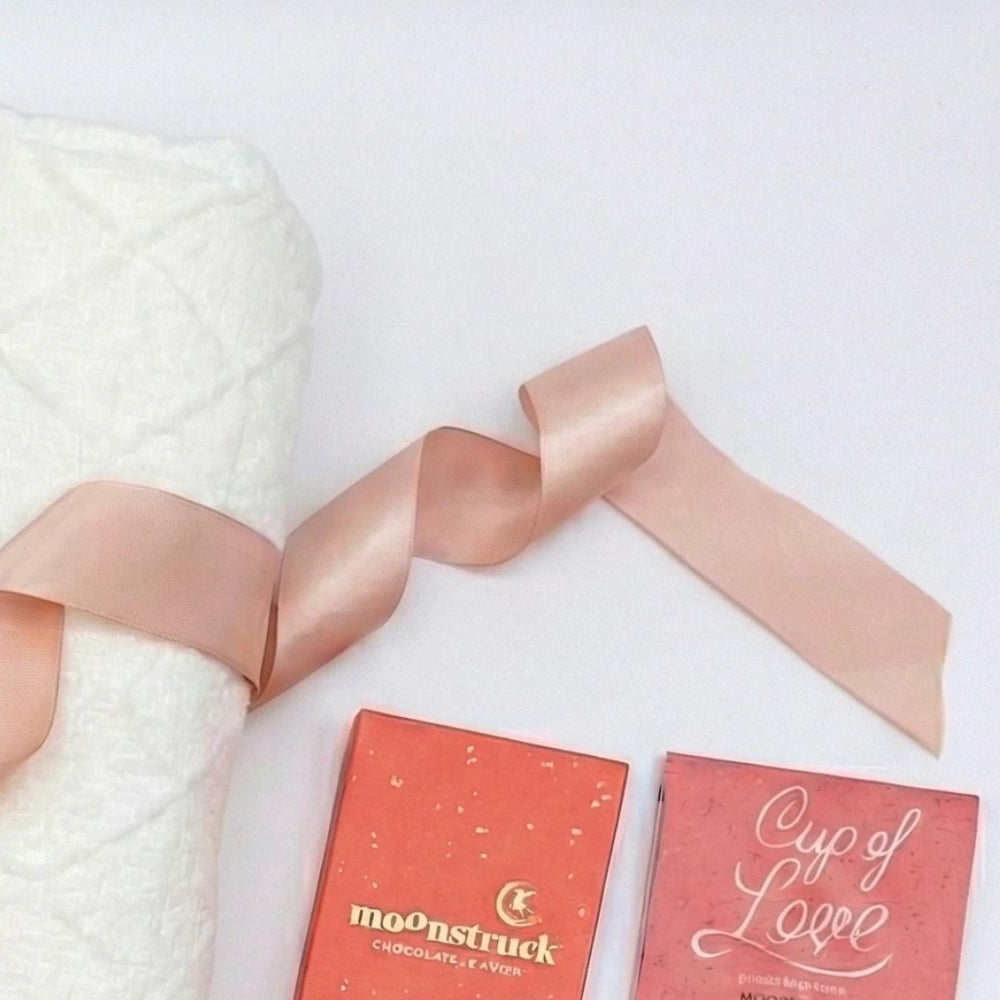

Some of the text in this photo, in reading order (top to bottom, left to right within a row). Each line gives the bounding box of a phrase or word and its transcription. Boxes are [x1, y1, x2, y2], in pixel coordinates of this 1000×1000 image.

[756, 785, 922, 892] Cup of
[349, 903, 557, 966] moonstruck
